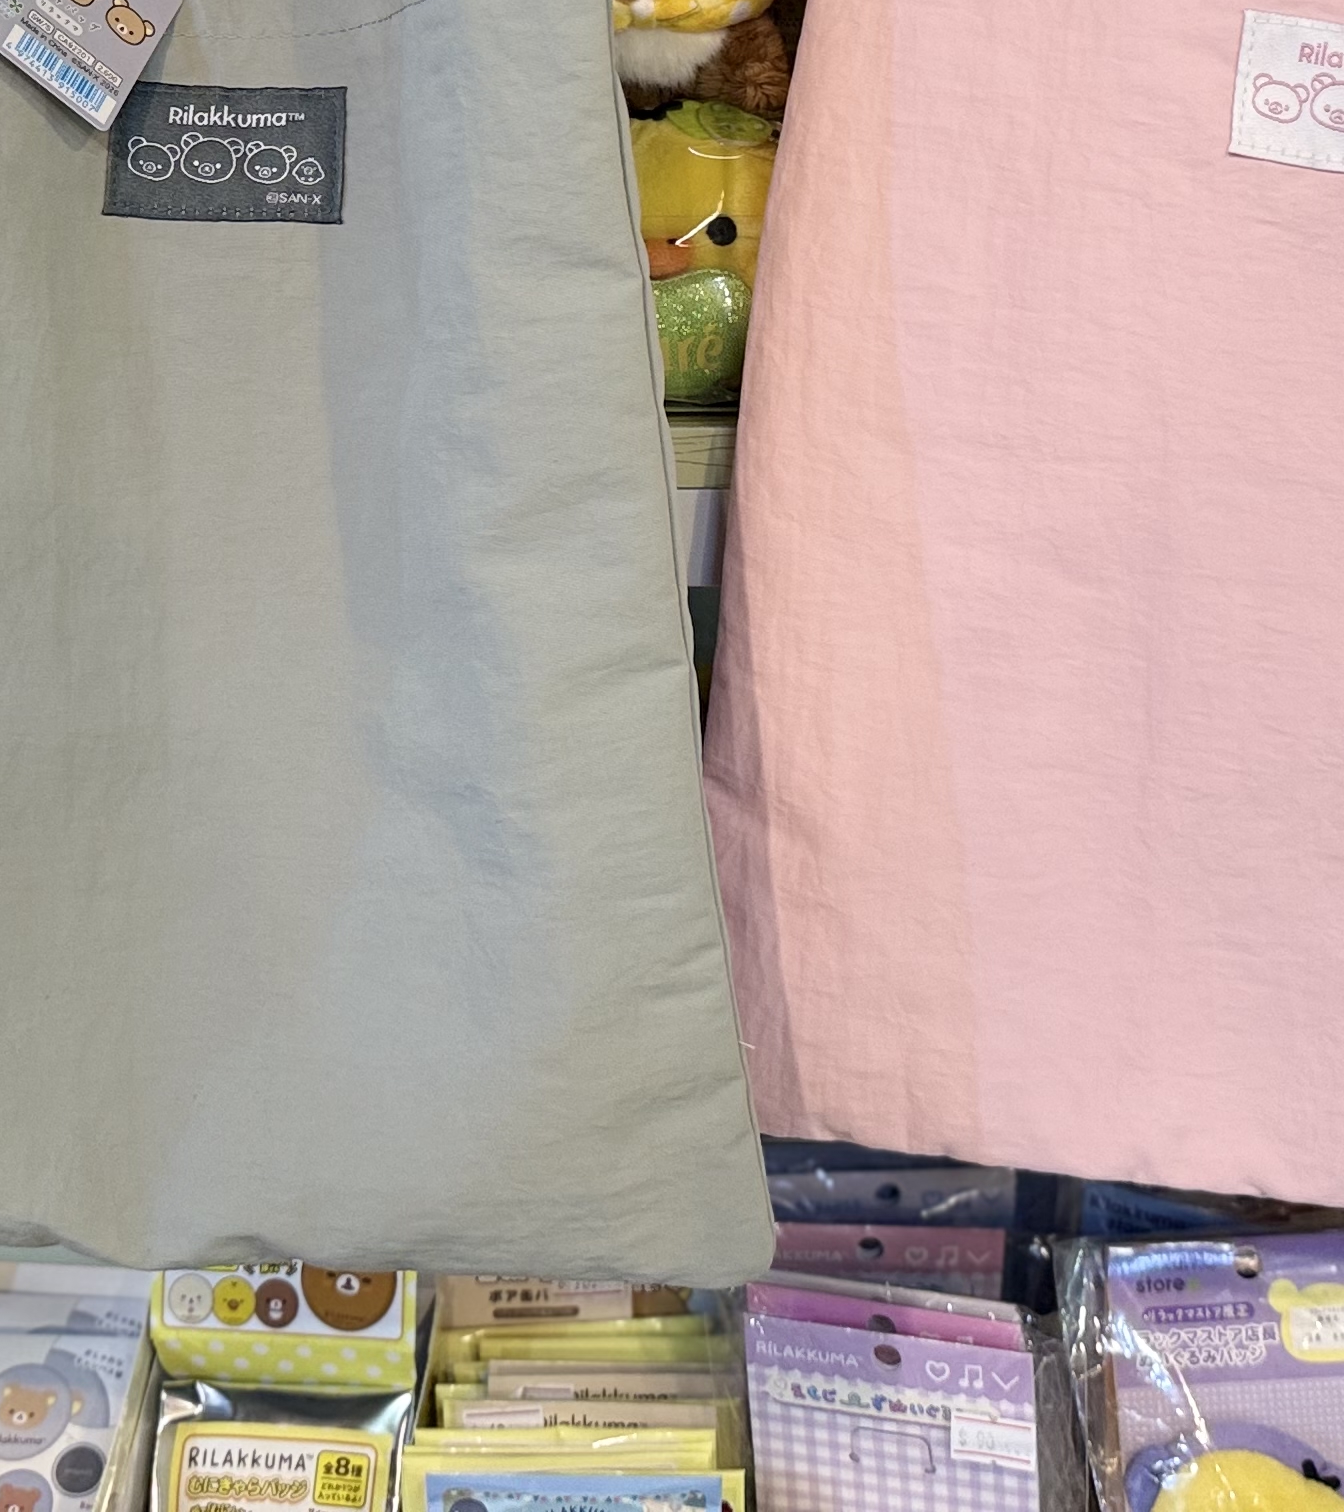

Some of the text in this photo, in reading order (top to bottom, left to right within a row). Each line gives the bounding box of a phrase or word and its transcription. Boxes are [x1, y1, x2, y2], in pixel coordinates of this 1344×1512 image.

[20, 17, 40, 35] Made
[1136, 1276, 1185, 1293] store
[322, 1456, 363, 1478] 全8種
